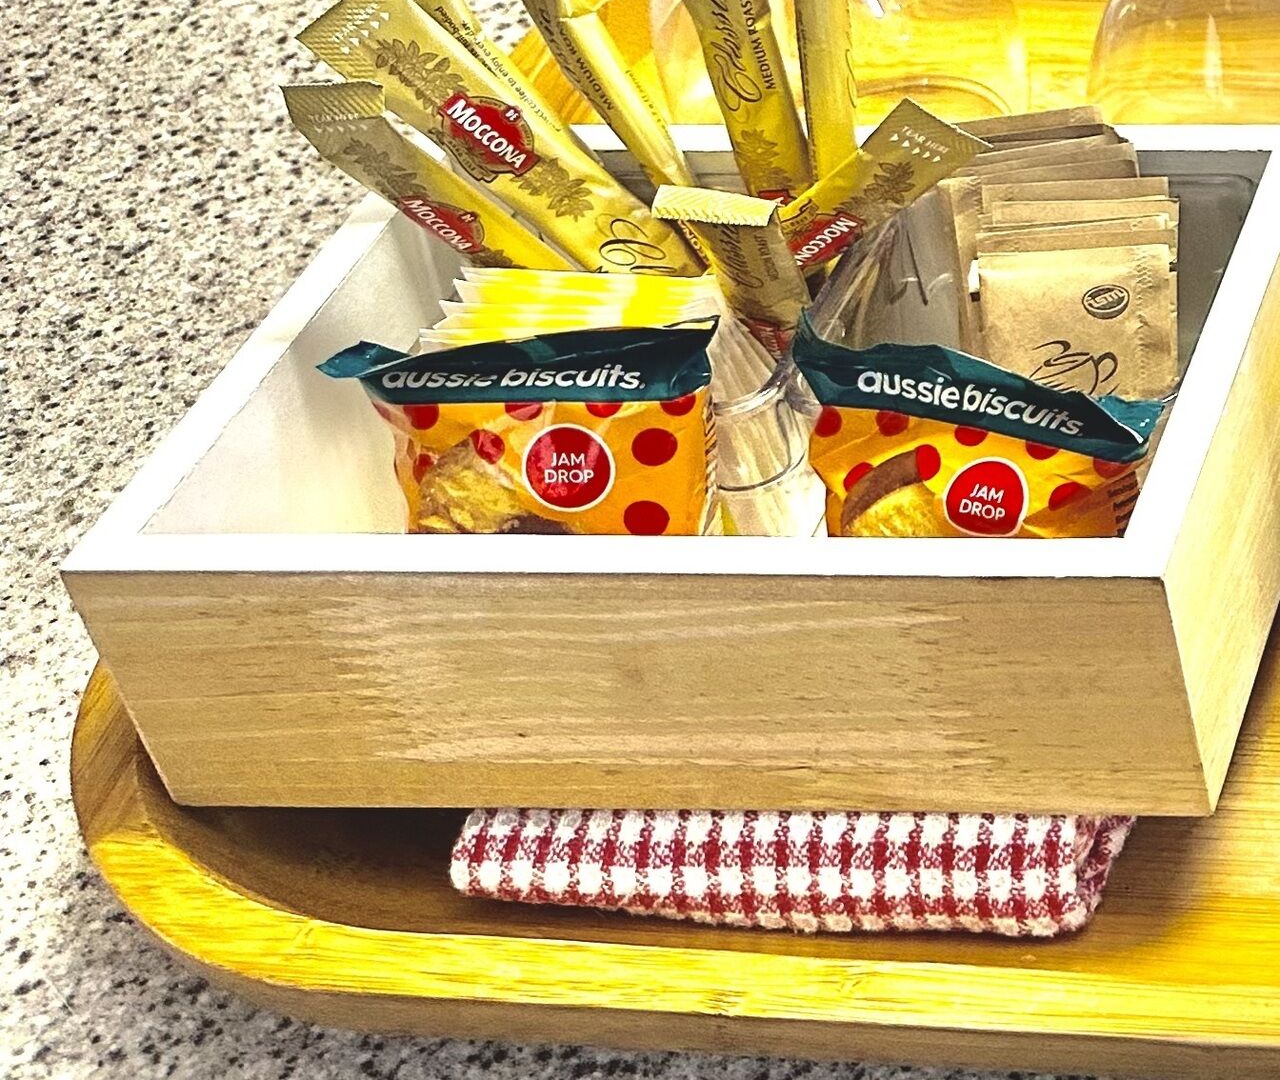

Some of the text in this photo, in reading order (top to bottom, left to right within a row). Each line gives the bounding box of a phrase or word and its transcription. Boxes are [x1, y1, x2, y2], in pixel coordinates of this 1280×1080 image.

[559, 21, 614, 111] MEDIUM ROA
[750, 36, 777, 91] MEDIUM
[446, 97, 530, 170] MOCCONA
[403, 197, 473, 253] MOCCONA
[795, 216, 859, 267] MOCCON
[381, 367, 498, 390] aussie
[857, 370, 960, 410] aussie
[543, 468, 595, 485] DROP
[550, 452, 586, 468] JAM
[959, 499, 1006, 521] DROP
[970, 483, 1005, 504] JAM
